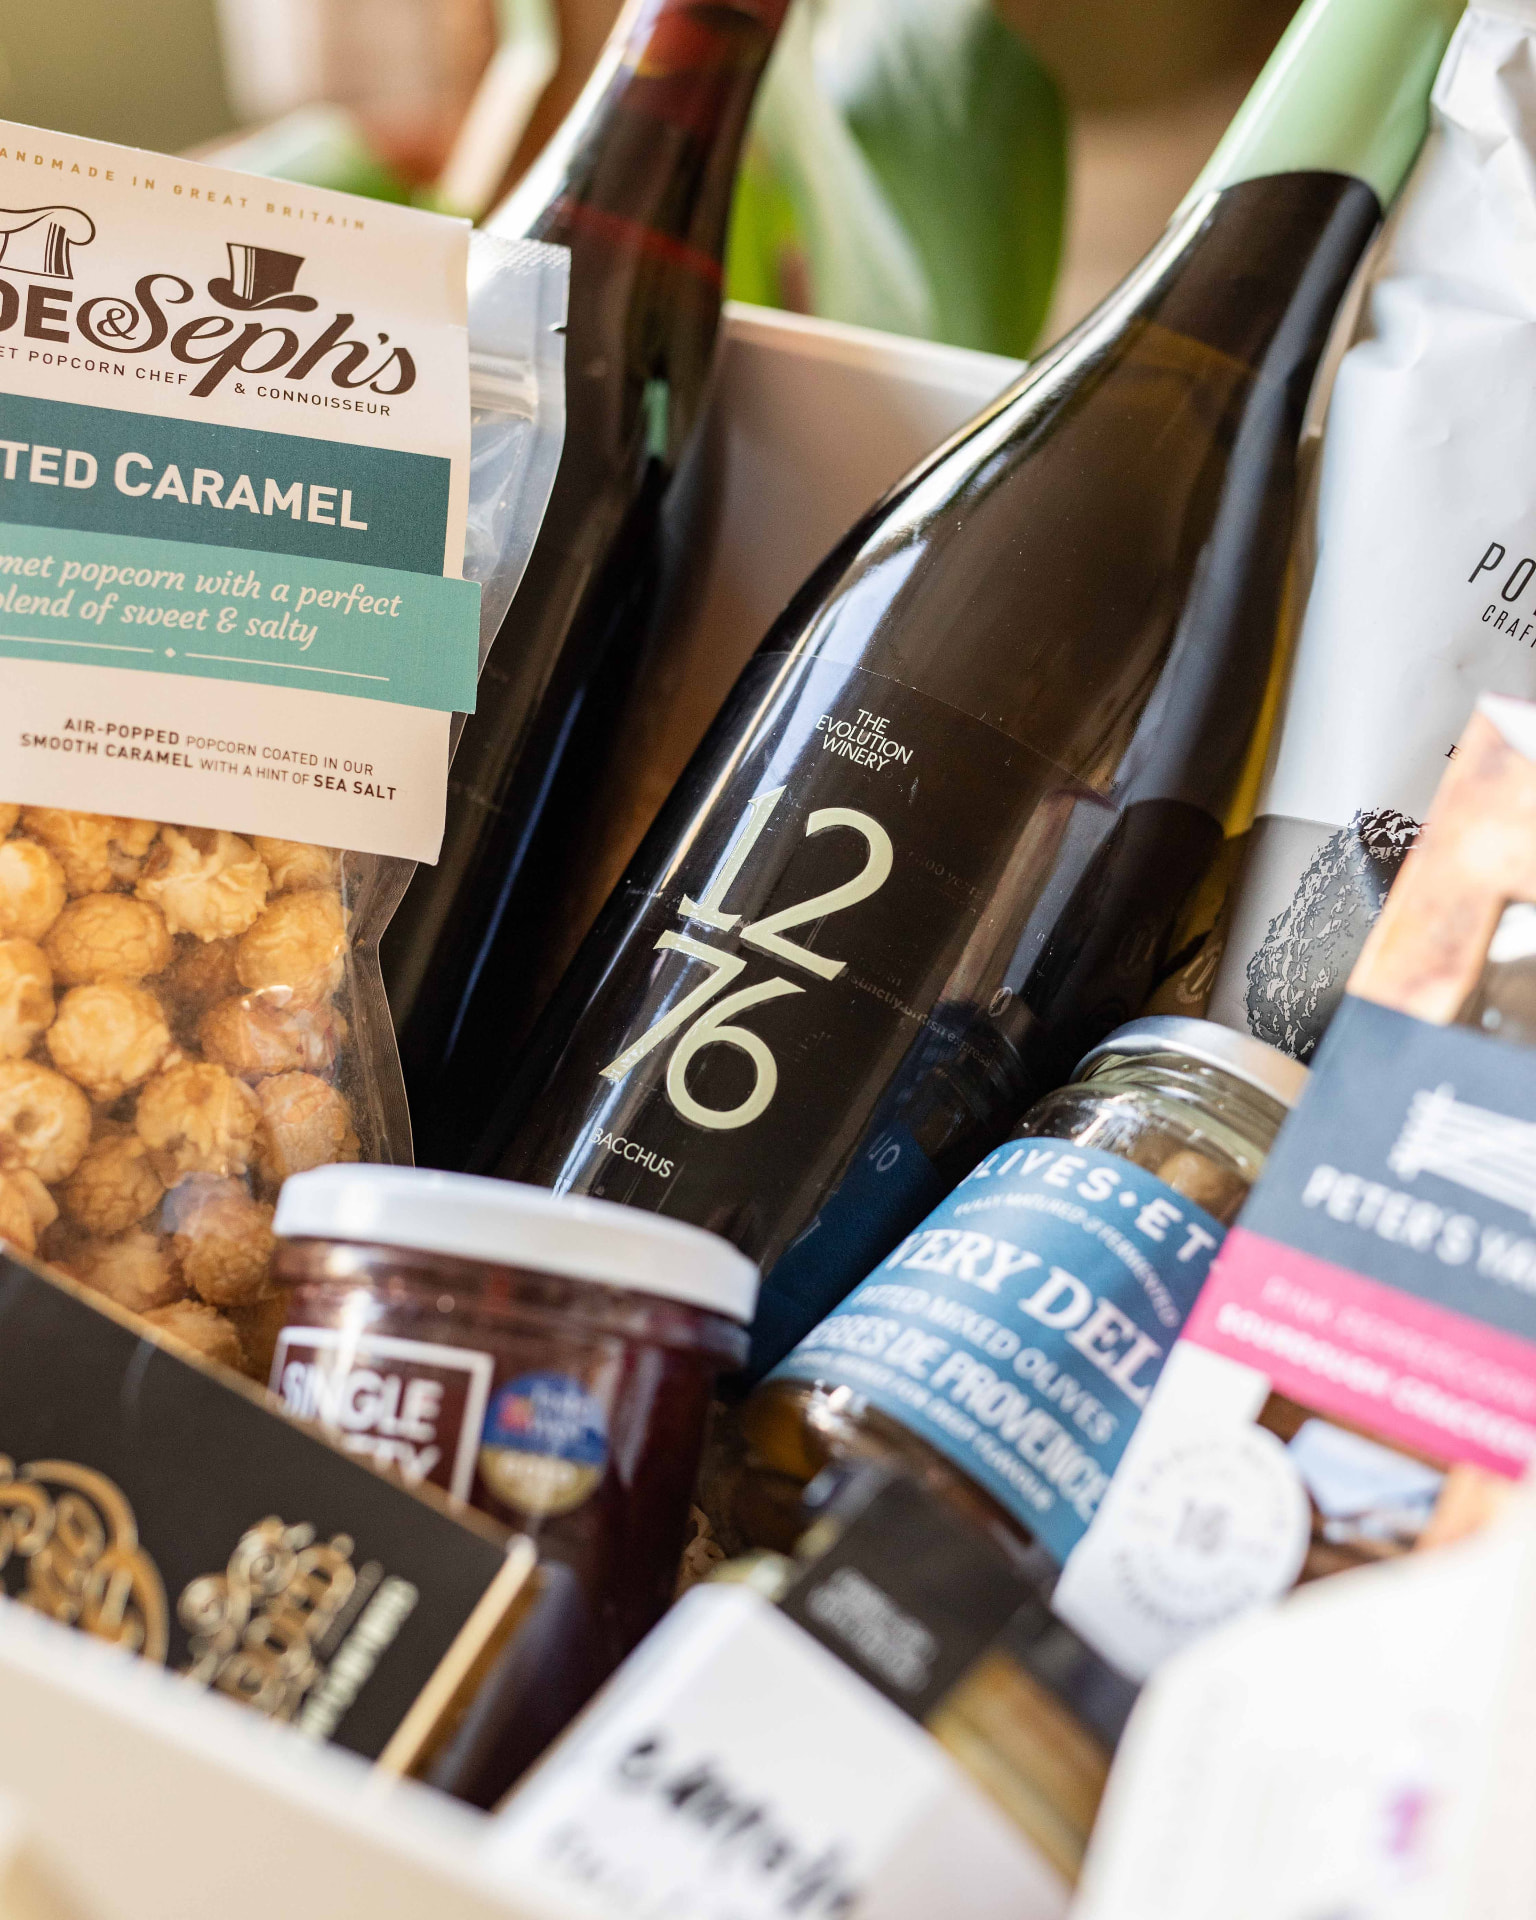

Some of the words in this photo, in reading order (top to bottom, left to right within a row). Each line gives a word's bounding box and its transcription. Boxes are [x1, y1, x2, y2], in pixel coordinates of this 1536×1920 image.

[132, 175, 156, 191] IN
[173, 184, 248, 208] GREAT
[266, 202, 366, 231] BRITAIN
[76, 273, 417, 398] Seph's
[96, 307, 138, 341] &
[29, 350, 126, 377] POPCORN
[135, 367, 189, 386] CHEF
[234, 381, 246, 395] &
[257, 385, 391, 417] CONNOISSEUR
[0, 583, 75, 618] lend
[80, 592, 120, 626] of
[120, 603, 210, 631] sweet
[216, 606, 239, 634] &
[245, 611, 319, 652] salty
[58, 560, 186, 593] popcorn
[194, 569, 262, 599] with
[270, 583, 291, 603] a
[295, 583, 404, 618] perfect
[64, 717, 181, 746] AIR-POPPED
[186, 734, 257, 757] POPCORN
[262, 746, 319, 767] COATED
[323, 756, 339, 771] IN
[343, 759, 374, 777] OUR
[815, 714, 914, 765] EVOLUTION
[856, 708, 891, 735] THE
[20, 732, 99, 756] SMOOTH
[104, 743, 194, 770] CARAMEL
[199, 757, 238, 775] WITH
[242, 764, 253, 778] A
[256, 765, 290, 783] HINT
[292, 771, 311, 786] OF
[313, 773, 348, 793] SEA
[352, 780, 397, 802] SALT
[822, 733, 891, 773] WINERY
[677, 784, 895, 981] 12
[598, 929, 806, 1131] 76
[590, 1127, 675, 1178] BACCHUS
